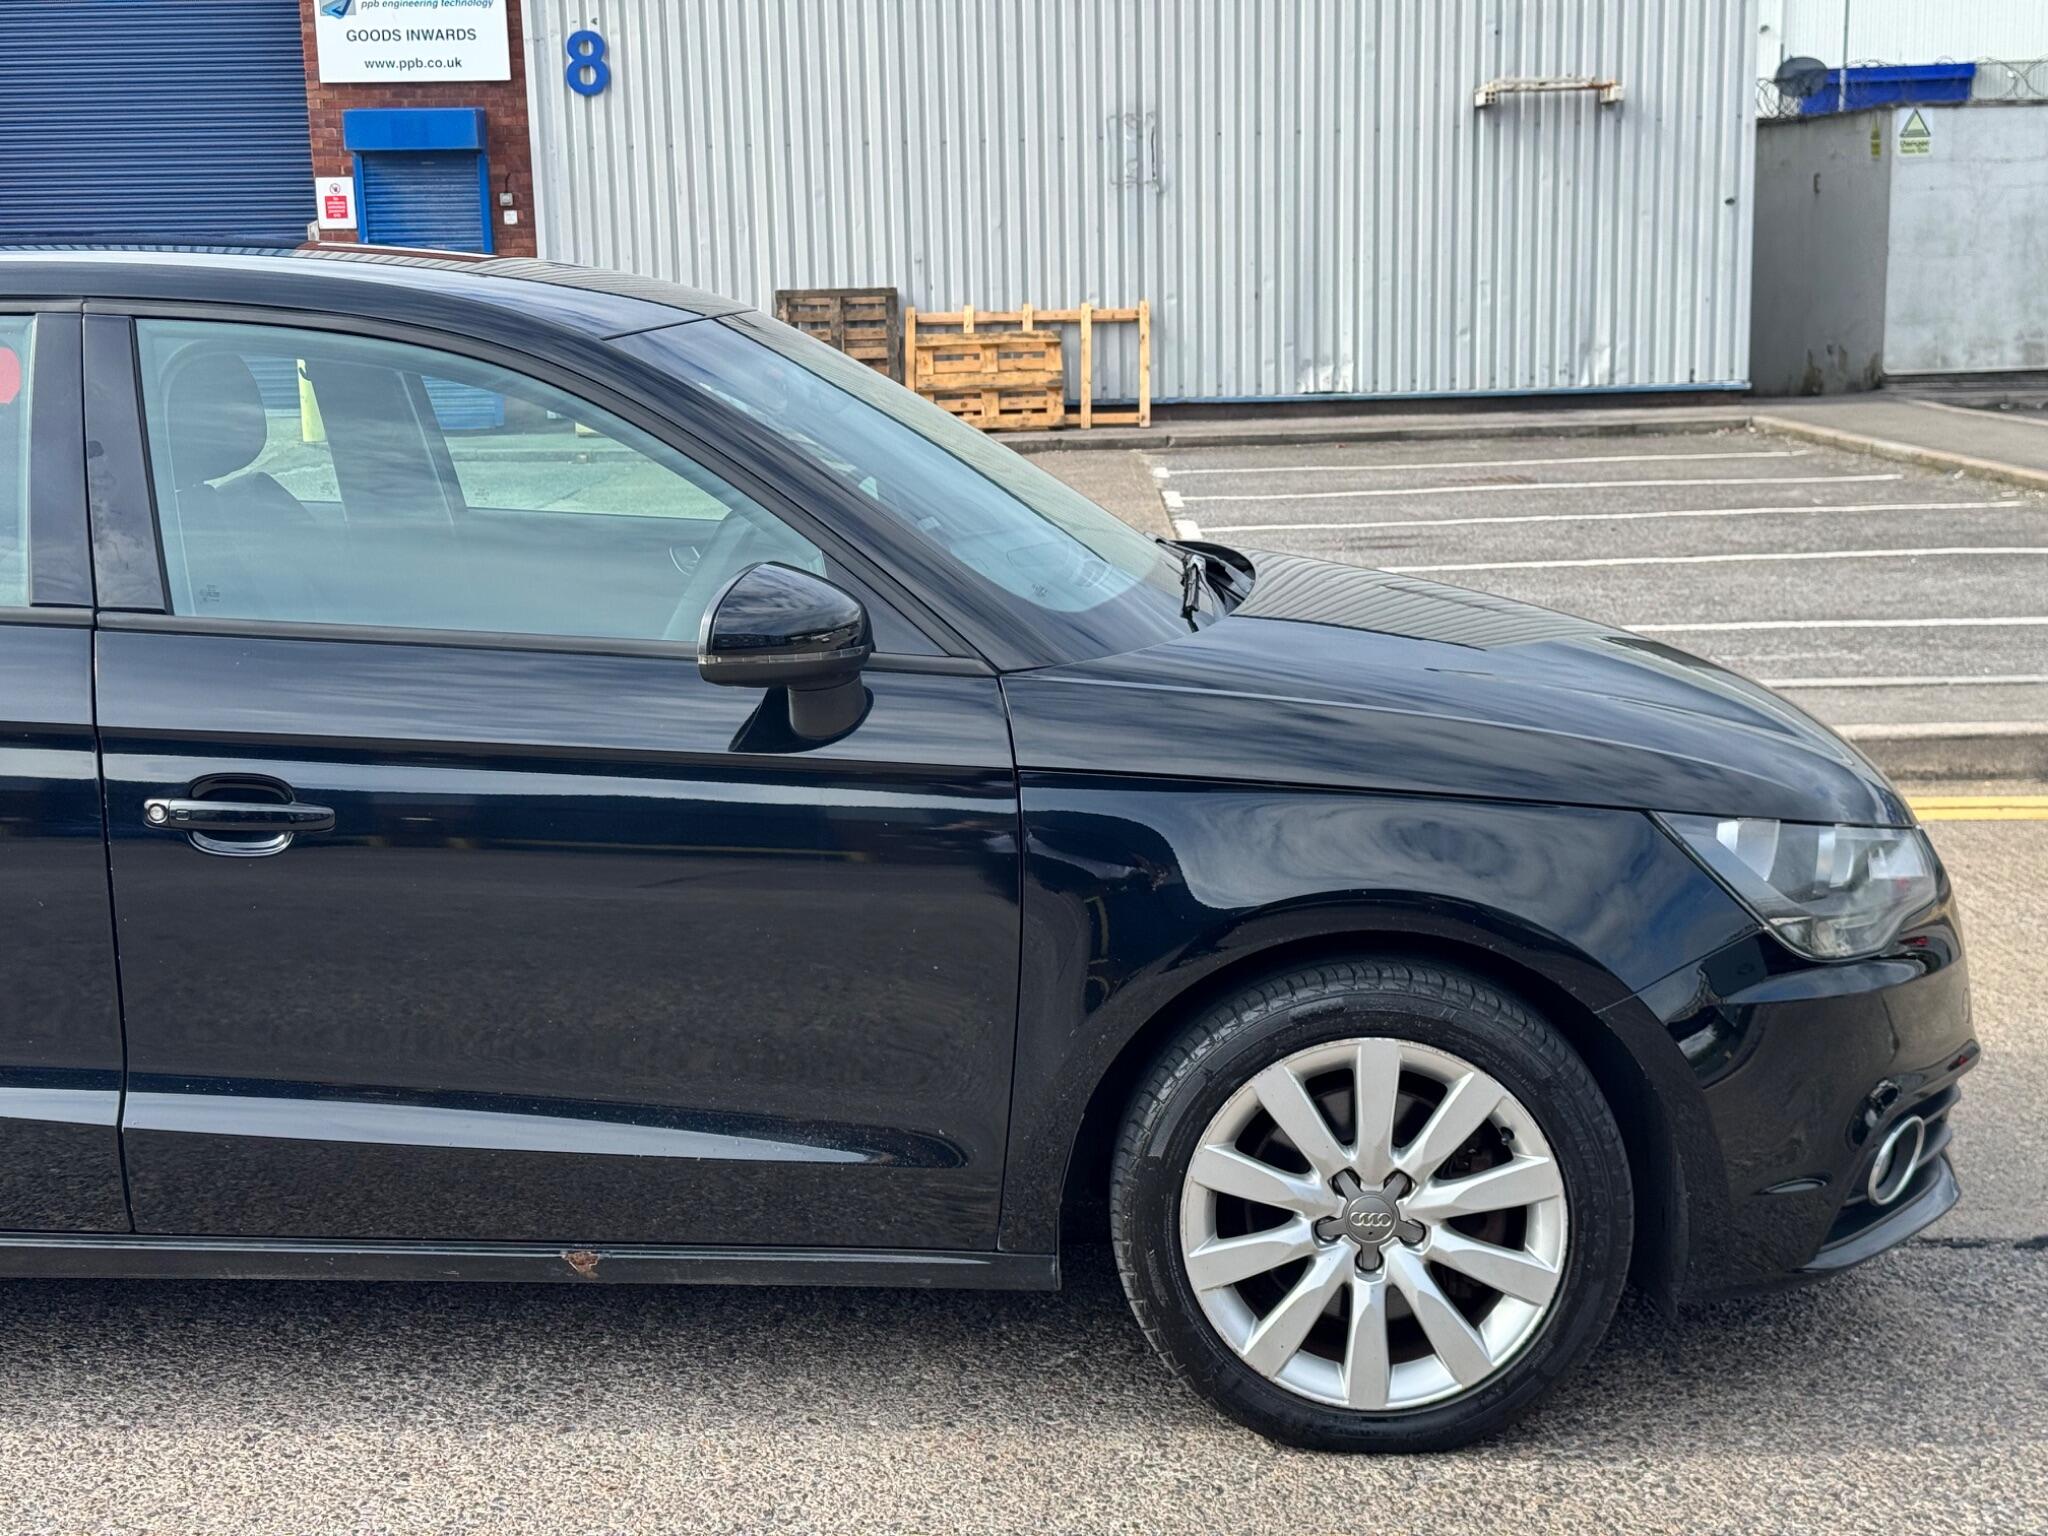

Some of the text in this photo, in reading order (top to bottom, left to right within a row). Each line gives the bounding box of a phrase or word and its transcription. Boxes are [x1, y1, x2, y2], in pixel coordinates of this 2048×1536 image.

[360, 0, 494, 10] ppb engineering technology
[346, 28, 477, 42] GOODS INWARDS
[364, 57, 462, 71] www.ppb.co.uk
[566, 30, 609, 96] 8
